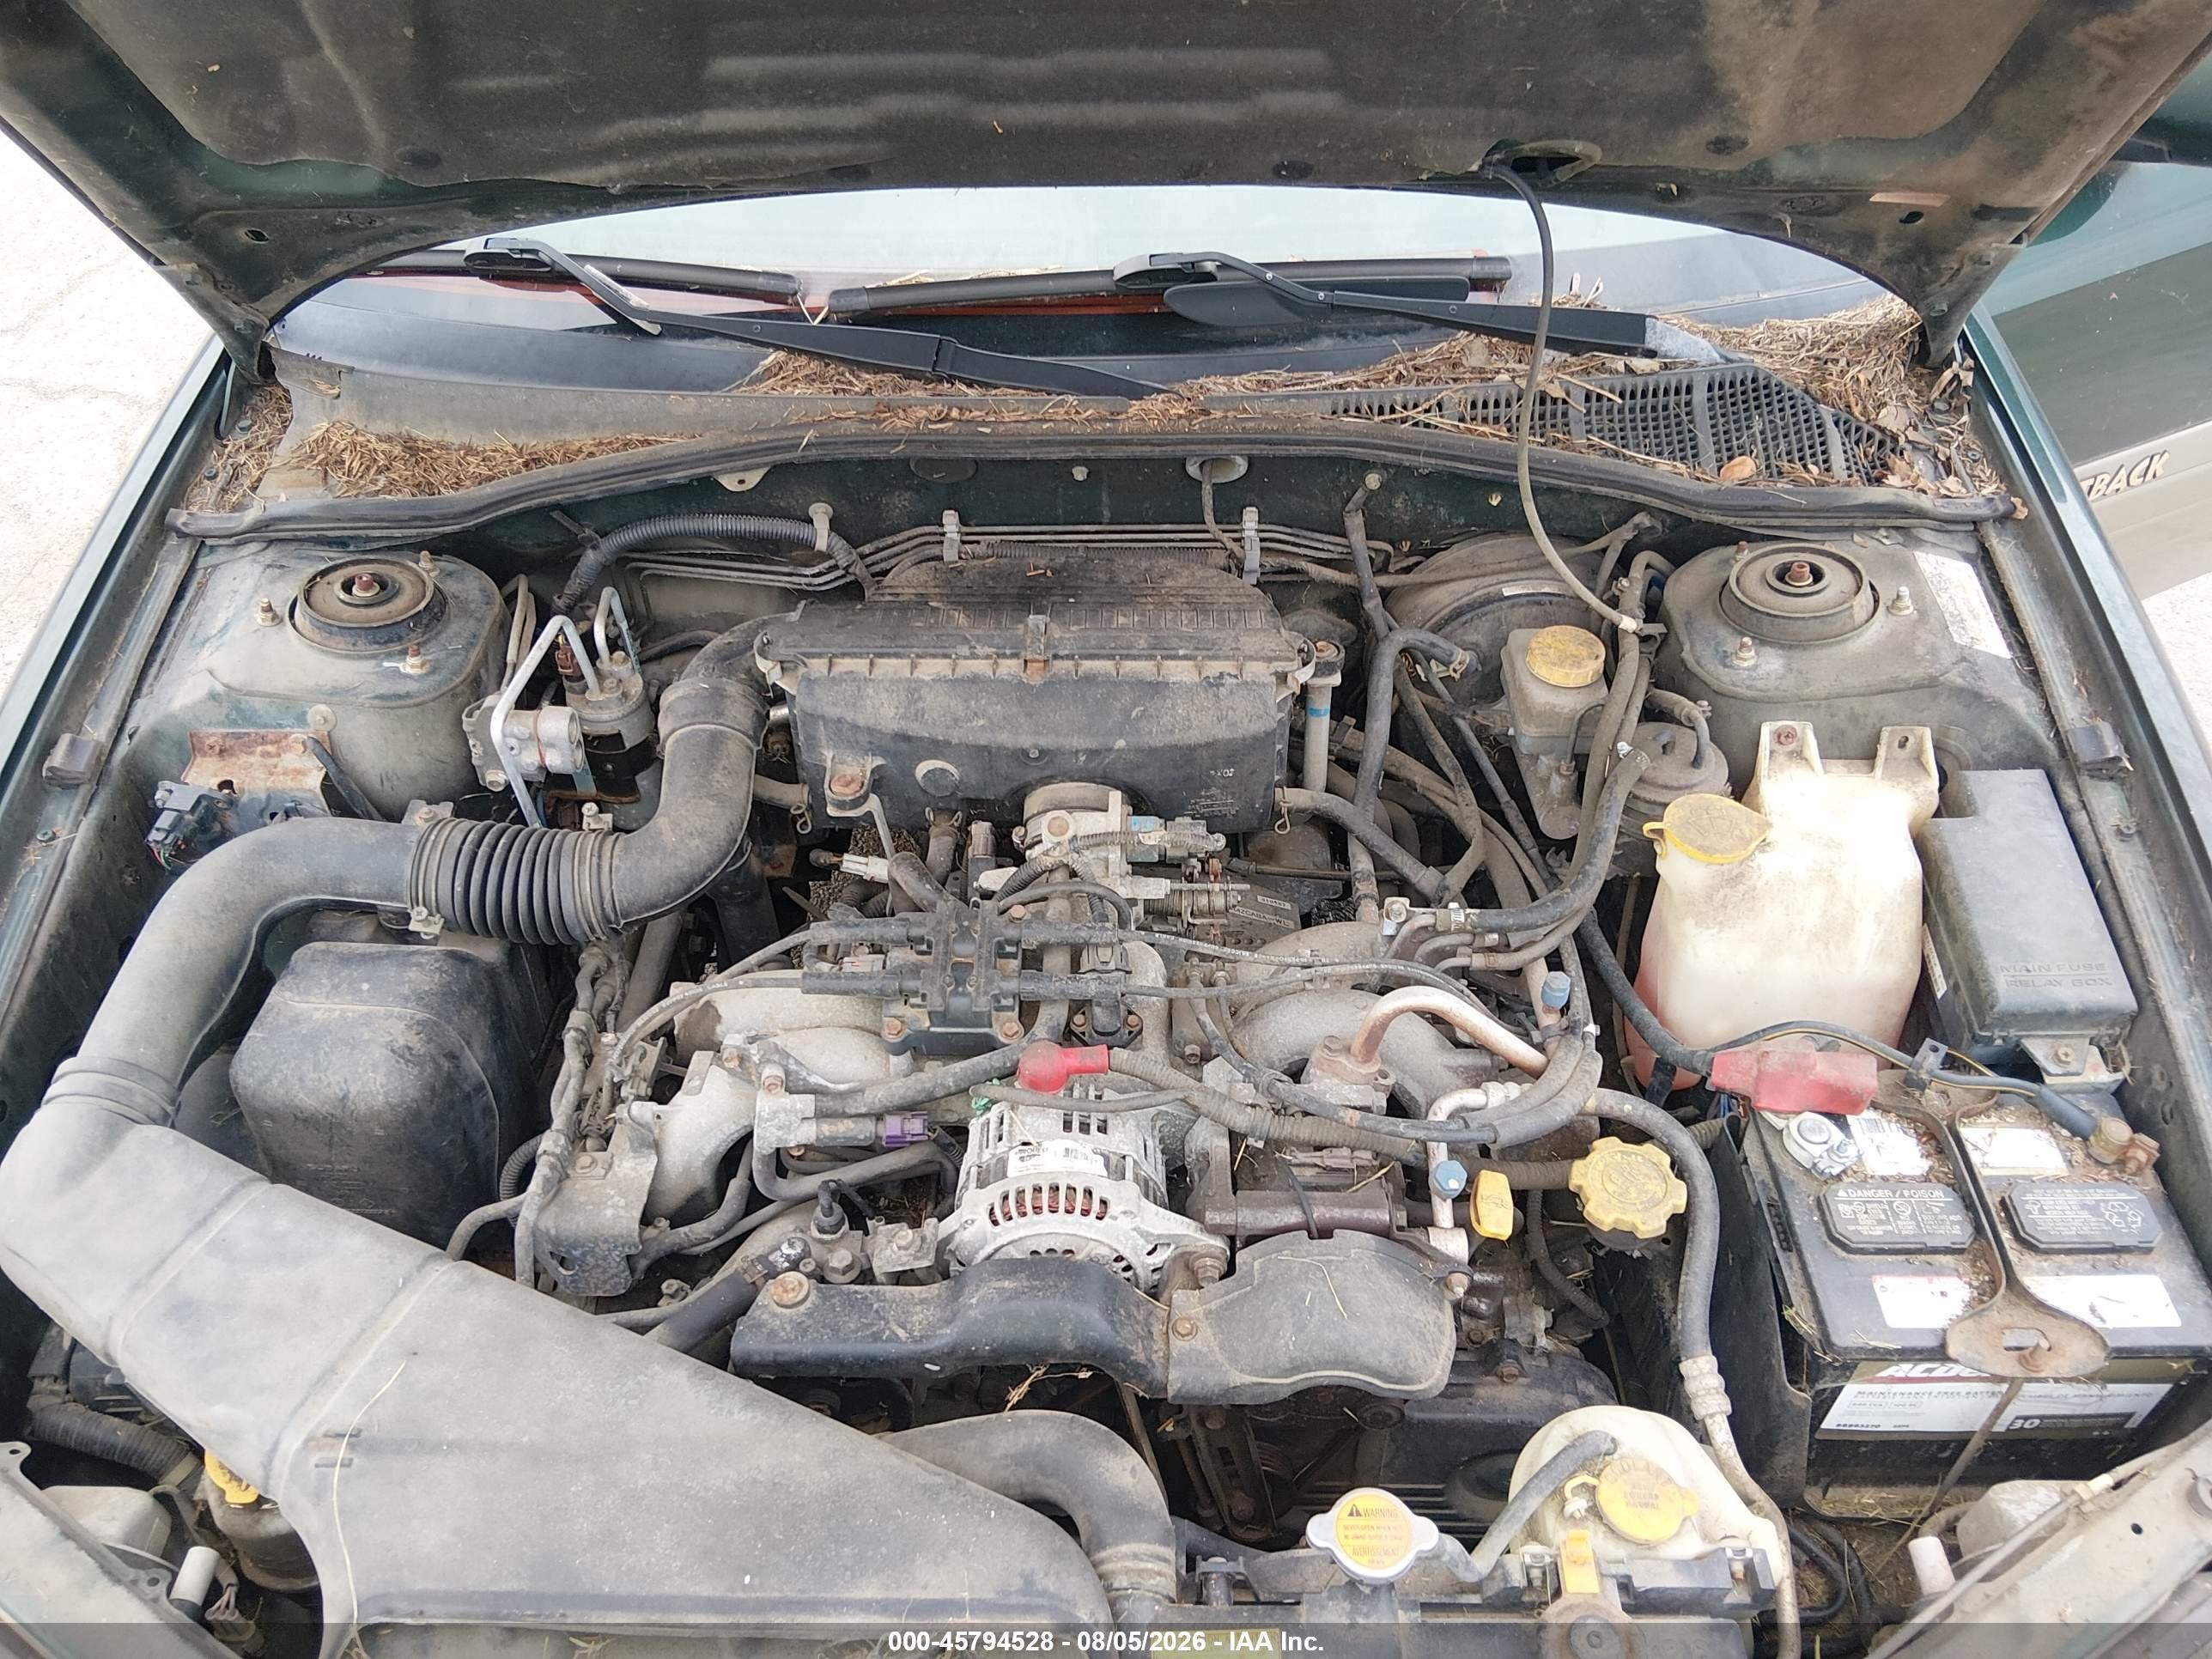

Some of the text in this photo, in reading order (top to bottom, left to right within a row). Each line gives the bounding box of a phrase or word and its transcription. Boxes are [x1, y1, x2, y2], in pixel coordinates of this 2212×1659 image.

[2000, 962, 2106, 973] MAIN FUSE
[2006, 977, 2114, 988] RELAY BOX
[1847, 1189, 1893, 1198] DANGER
[1903, 1188, 1945, 1199] POISON
[2008, 1419, 2041, 1430] 30
[1363, 1508, 1399, 1518] WARNING
